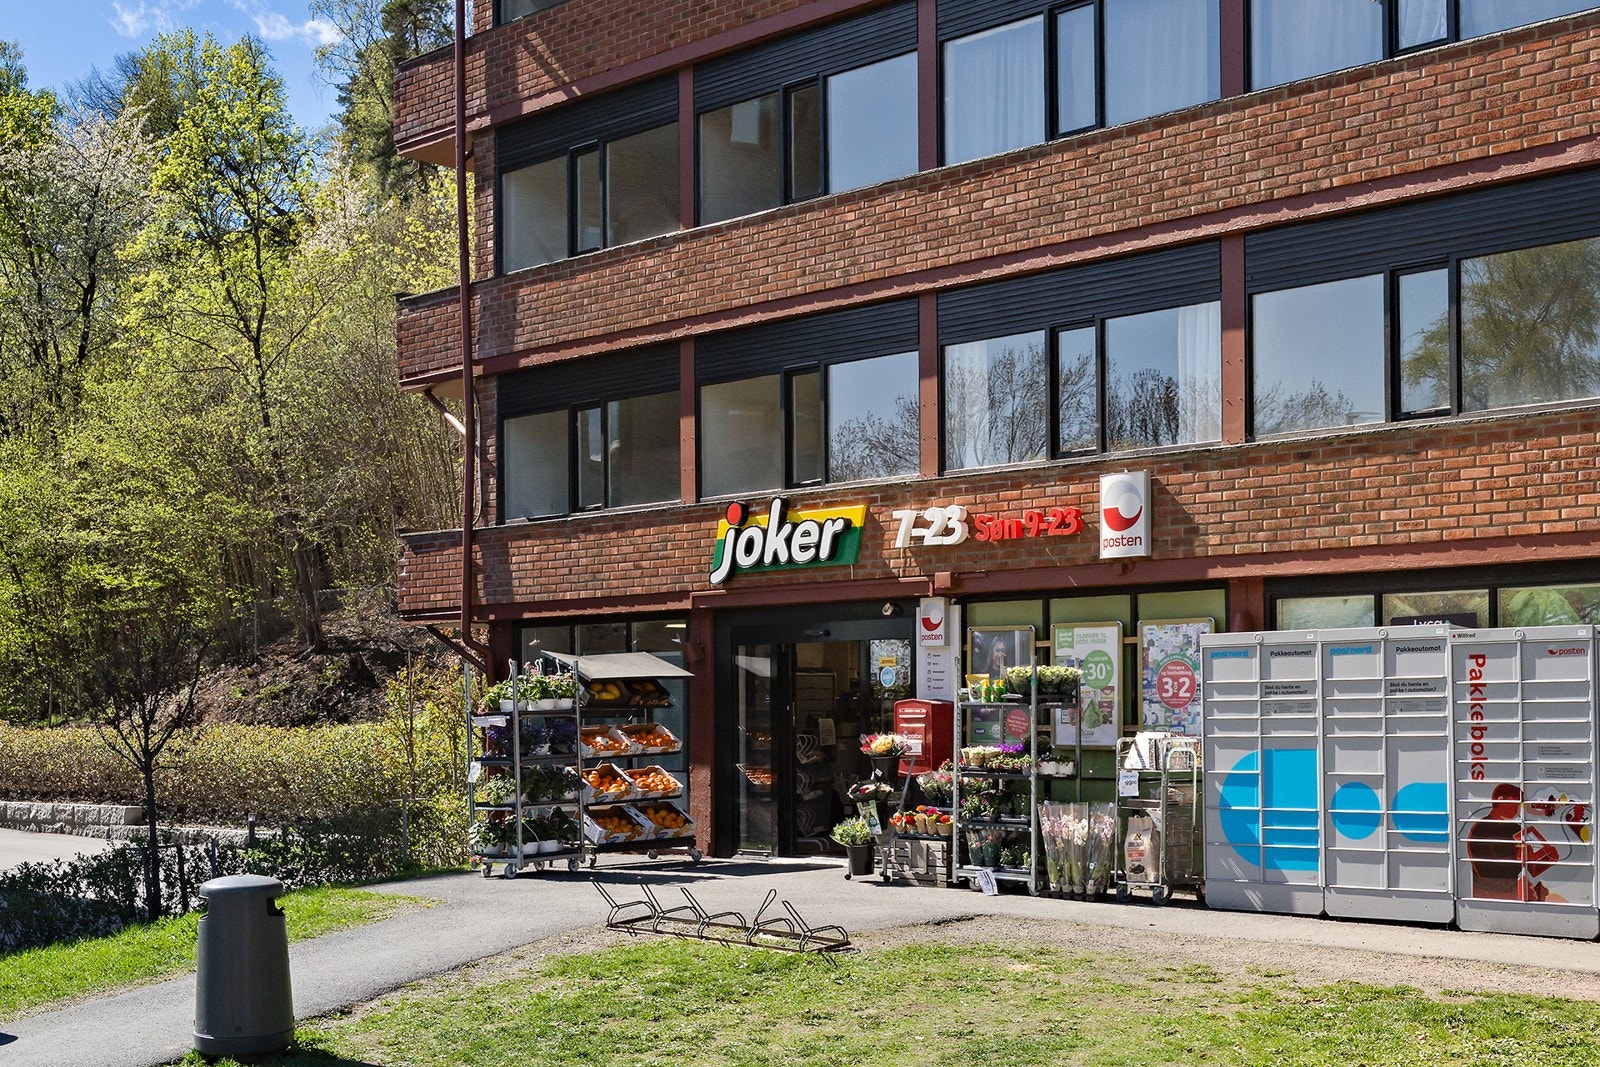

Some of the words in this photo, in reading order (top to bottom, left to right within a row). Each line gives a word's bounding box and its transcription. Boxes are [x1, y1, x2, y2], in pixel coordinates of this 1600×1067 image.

[893, 505, 969, 548] 7-23
[974, 513, 1023, 543] Søn
[1024, 506, 1083, 538] 9-23
[709, 498, 848, 585] joker
[1102, 533, 1143, 550] posten
[921, 633, 943, 641] posten
[1210, 649, 1249, 659] postnord
[1270, 649, 1312, 657] Pakkeautomat
[1329, 645, 1373, 656] postnord
[1395, 645, 1441, 653] Pakkeautomat
[1558, 647, 1585, 656] posten
[1161, 677, 1173, 698] 3
[1178, 677, 1191, 698] 2
[1468, 653, 1488, 781] Pakkeboks
